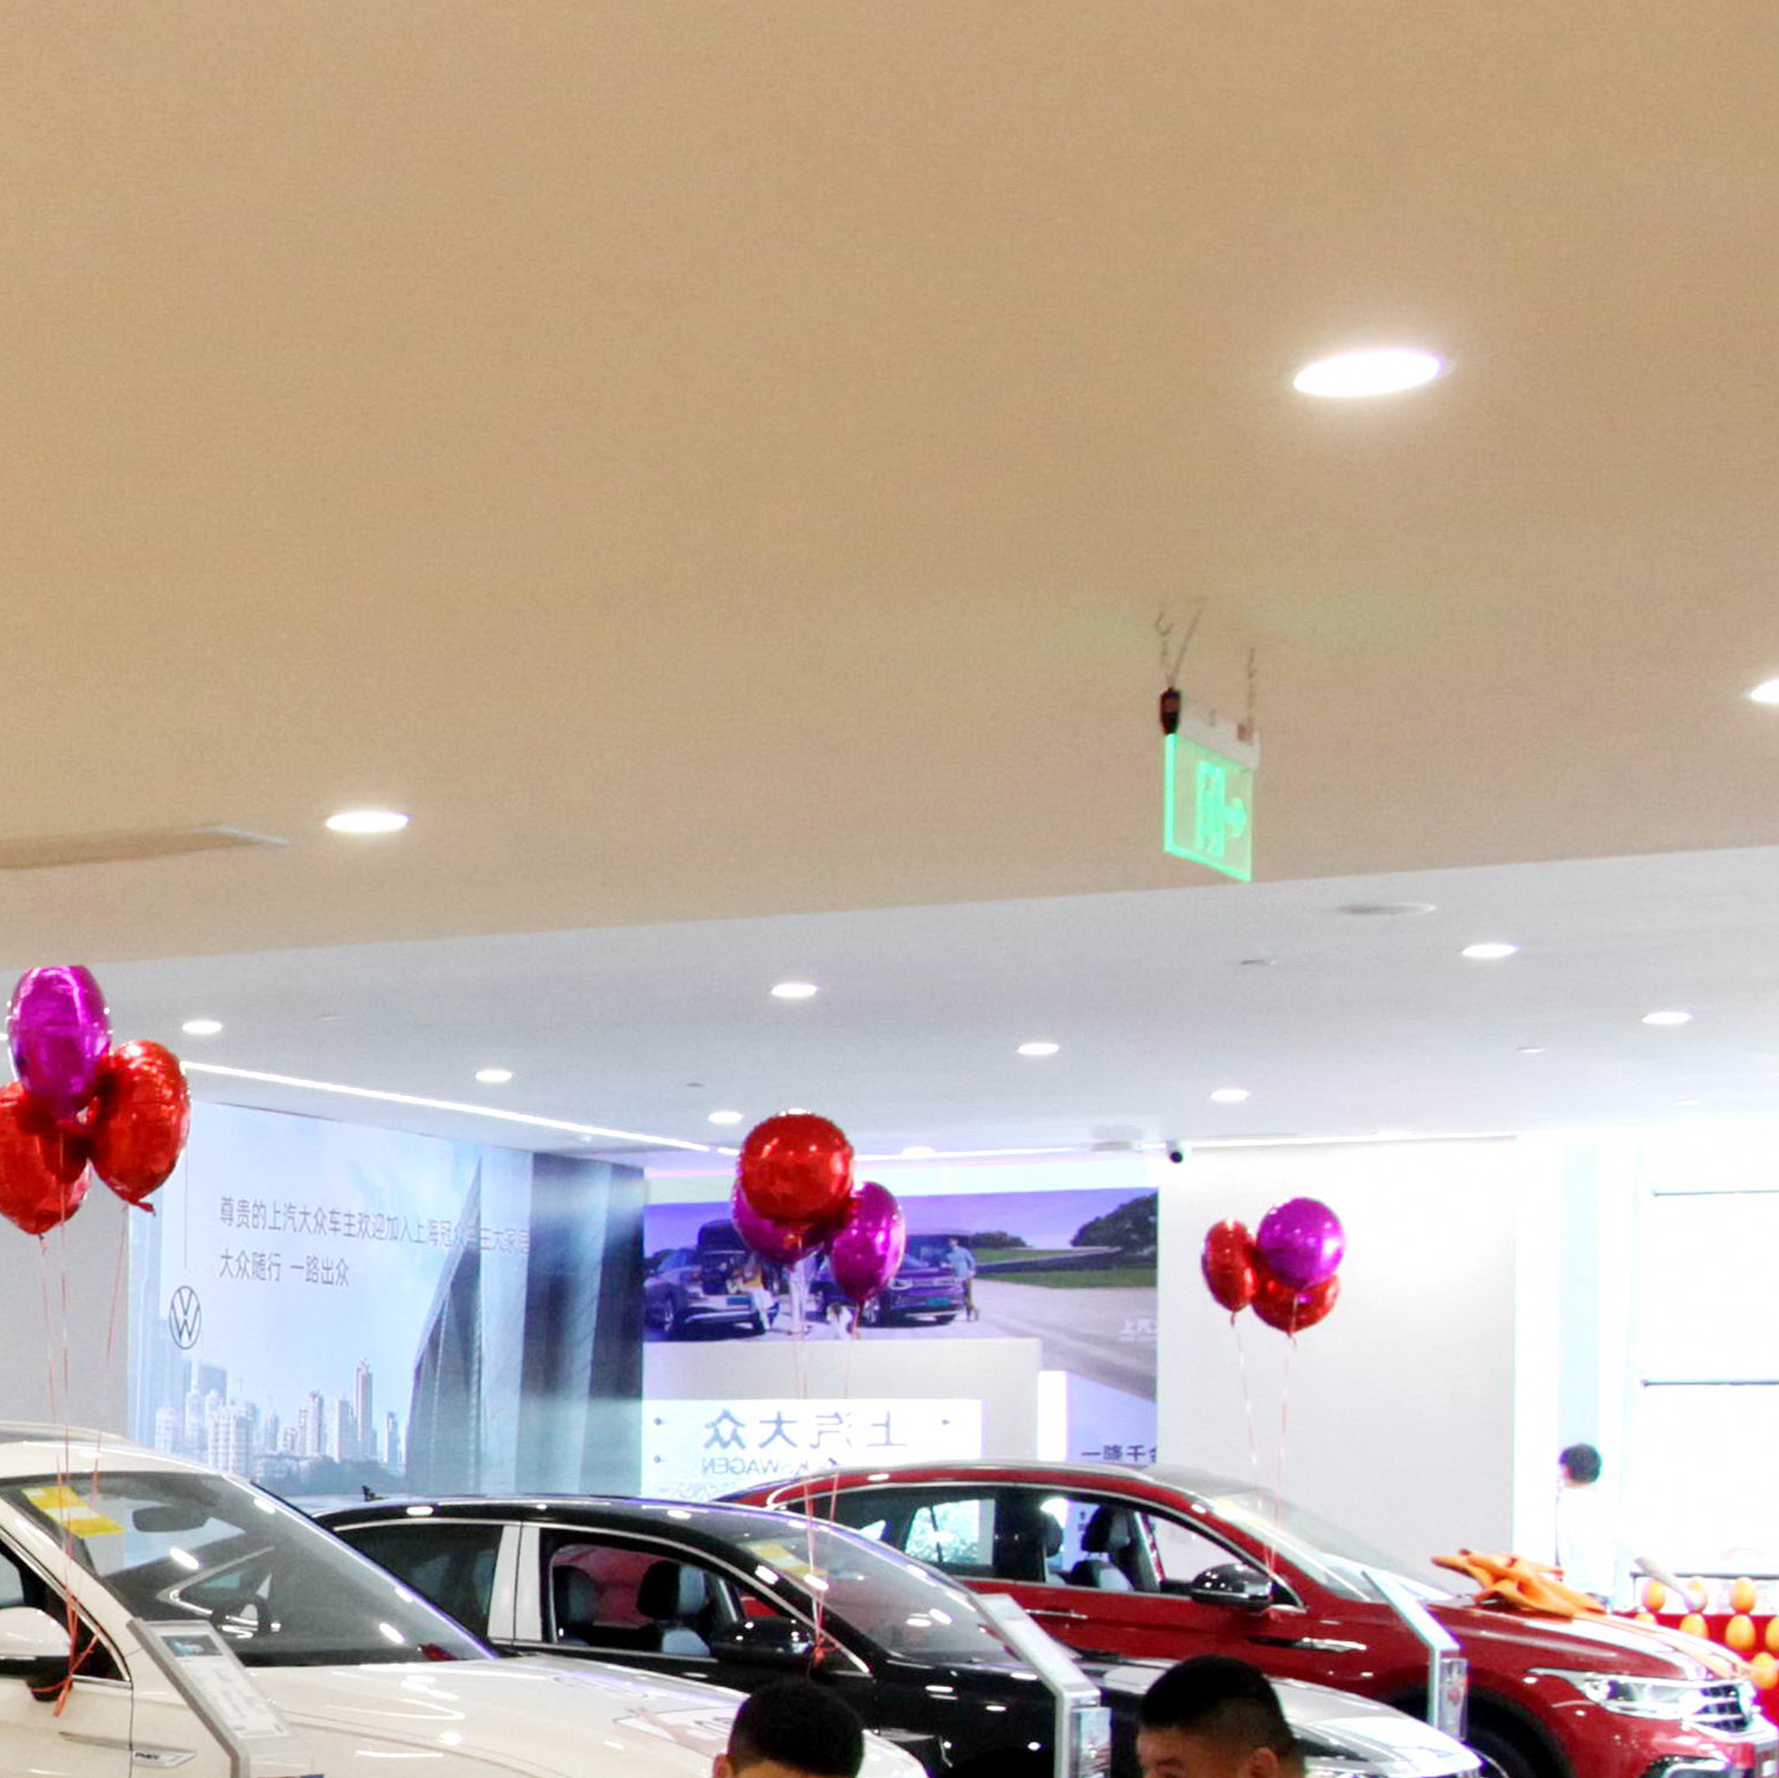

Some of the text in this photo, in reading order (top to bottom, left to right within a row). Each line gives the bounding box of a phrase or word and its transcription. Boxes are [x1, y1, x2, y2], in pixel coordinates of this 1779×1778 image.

[219, 1248, 350, 1287] 大众随行 一路出众
